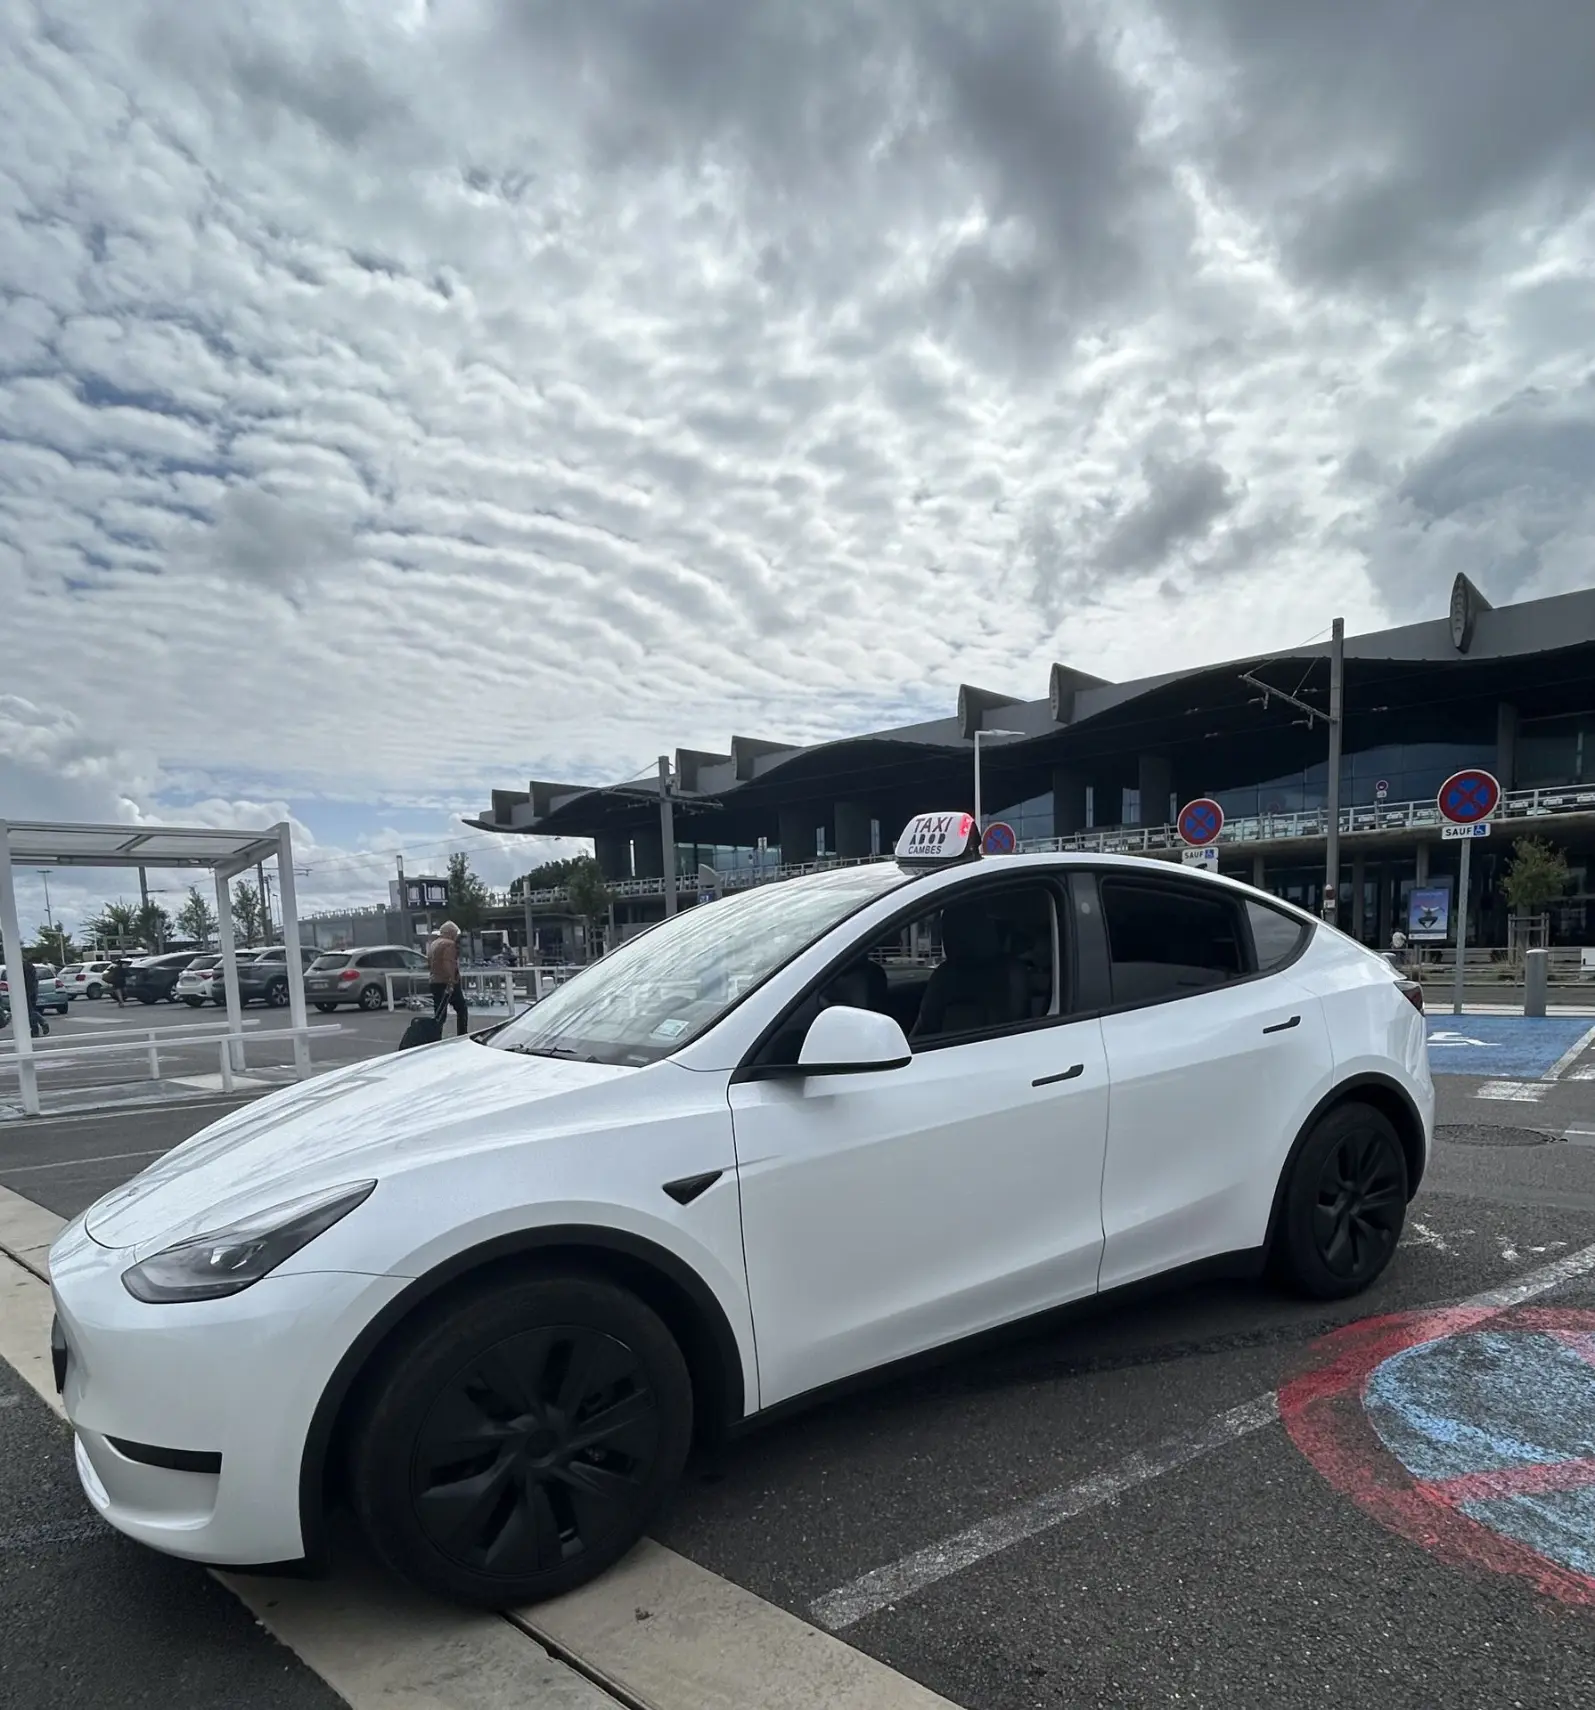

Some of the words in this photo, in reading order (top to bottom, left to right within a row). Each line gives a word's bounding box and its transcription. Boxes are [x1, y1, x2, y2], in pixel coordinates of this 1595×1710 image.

[913, 817, 953, 833] TAXI
[1445, 826, 1472, 836] SAUF
[908, 845, 942, 855] CAMBES
[1184, 851, 1204, 859] SAUF
